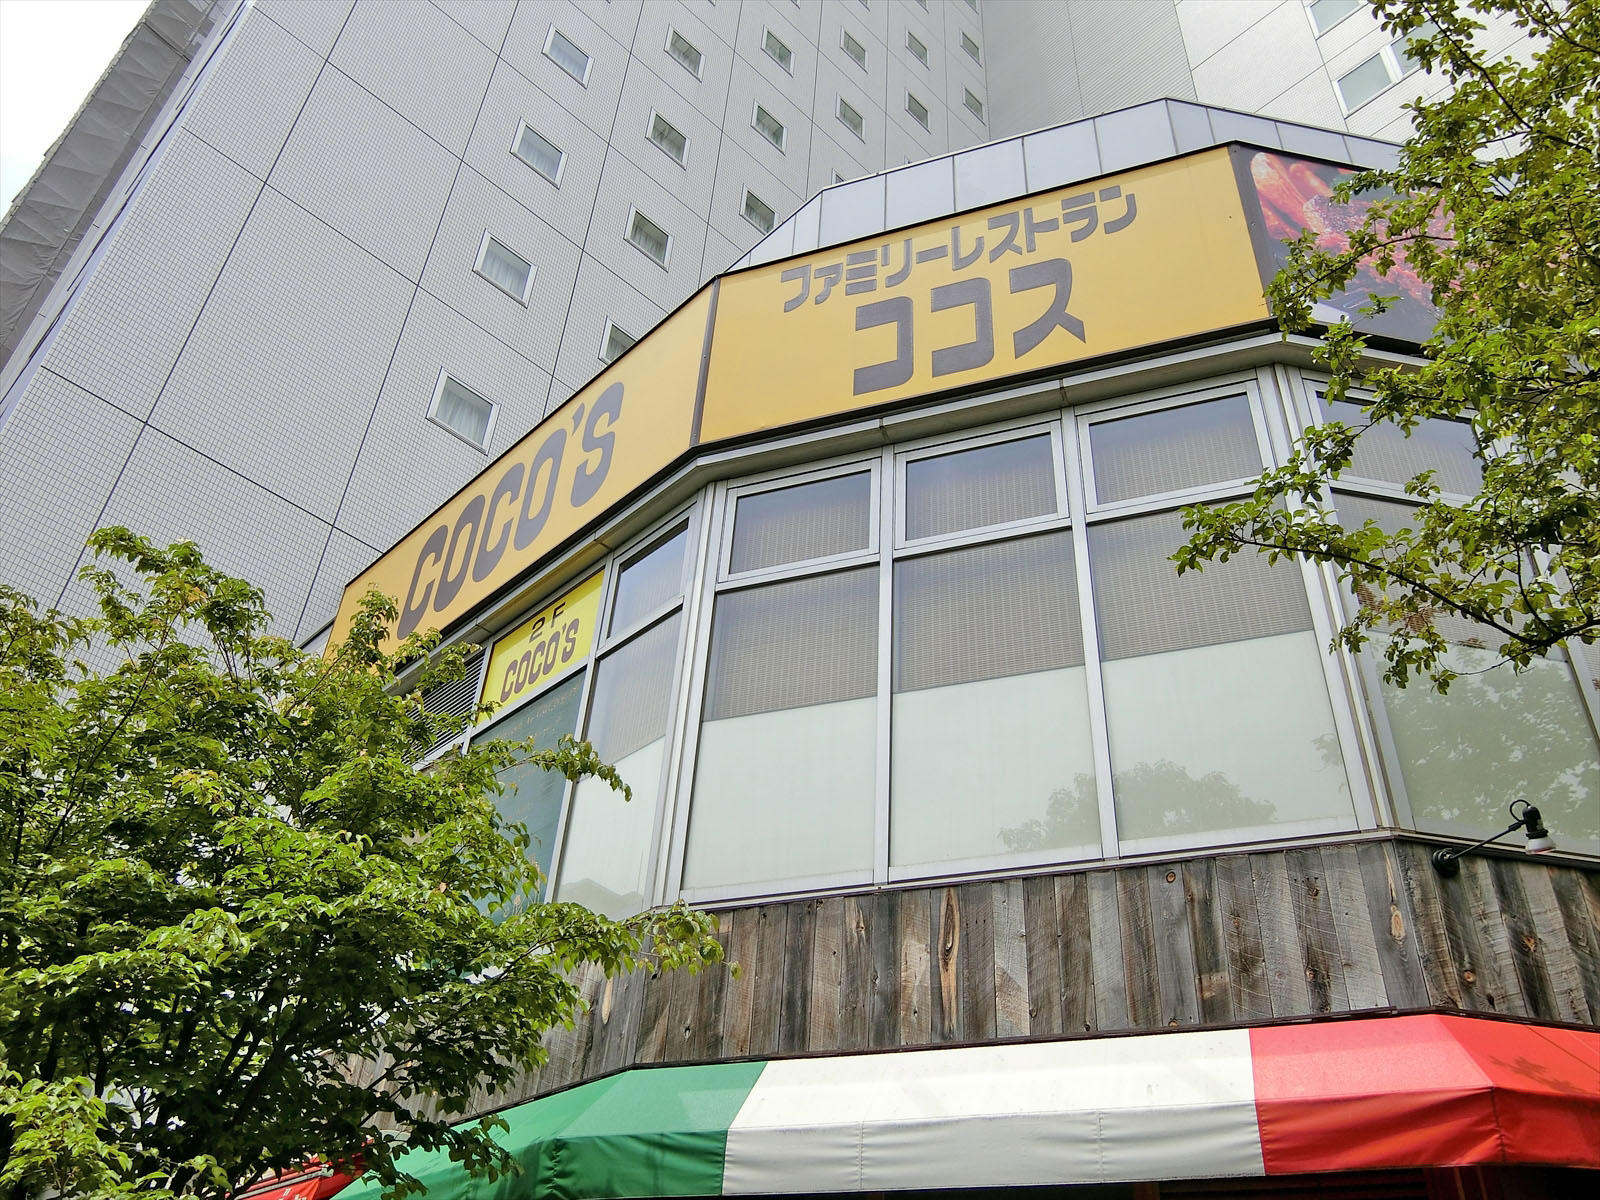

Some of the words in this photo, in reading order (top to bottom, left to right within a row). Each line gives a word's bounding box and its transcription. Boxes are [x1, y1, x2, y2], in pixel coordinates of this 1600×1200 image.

[781, 185, 1137, 313] ファミリーレストラン
[854, 257, 1086, 396] ココス
[397, 382, 624, 640] COCO'S
[500, 618, 580, 703] COCO'S
